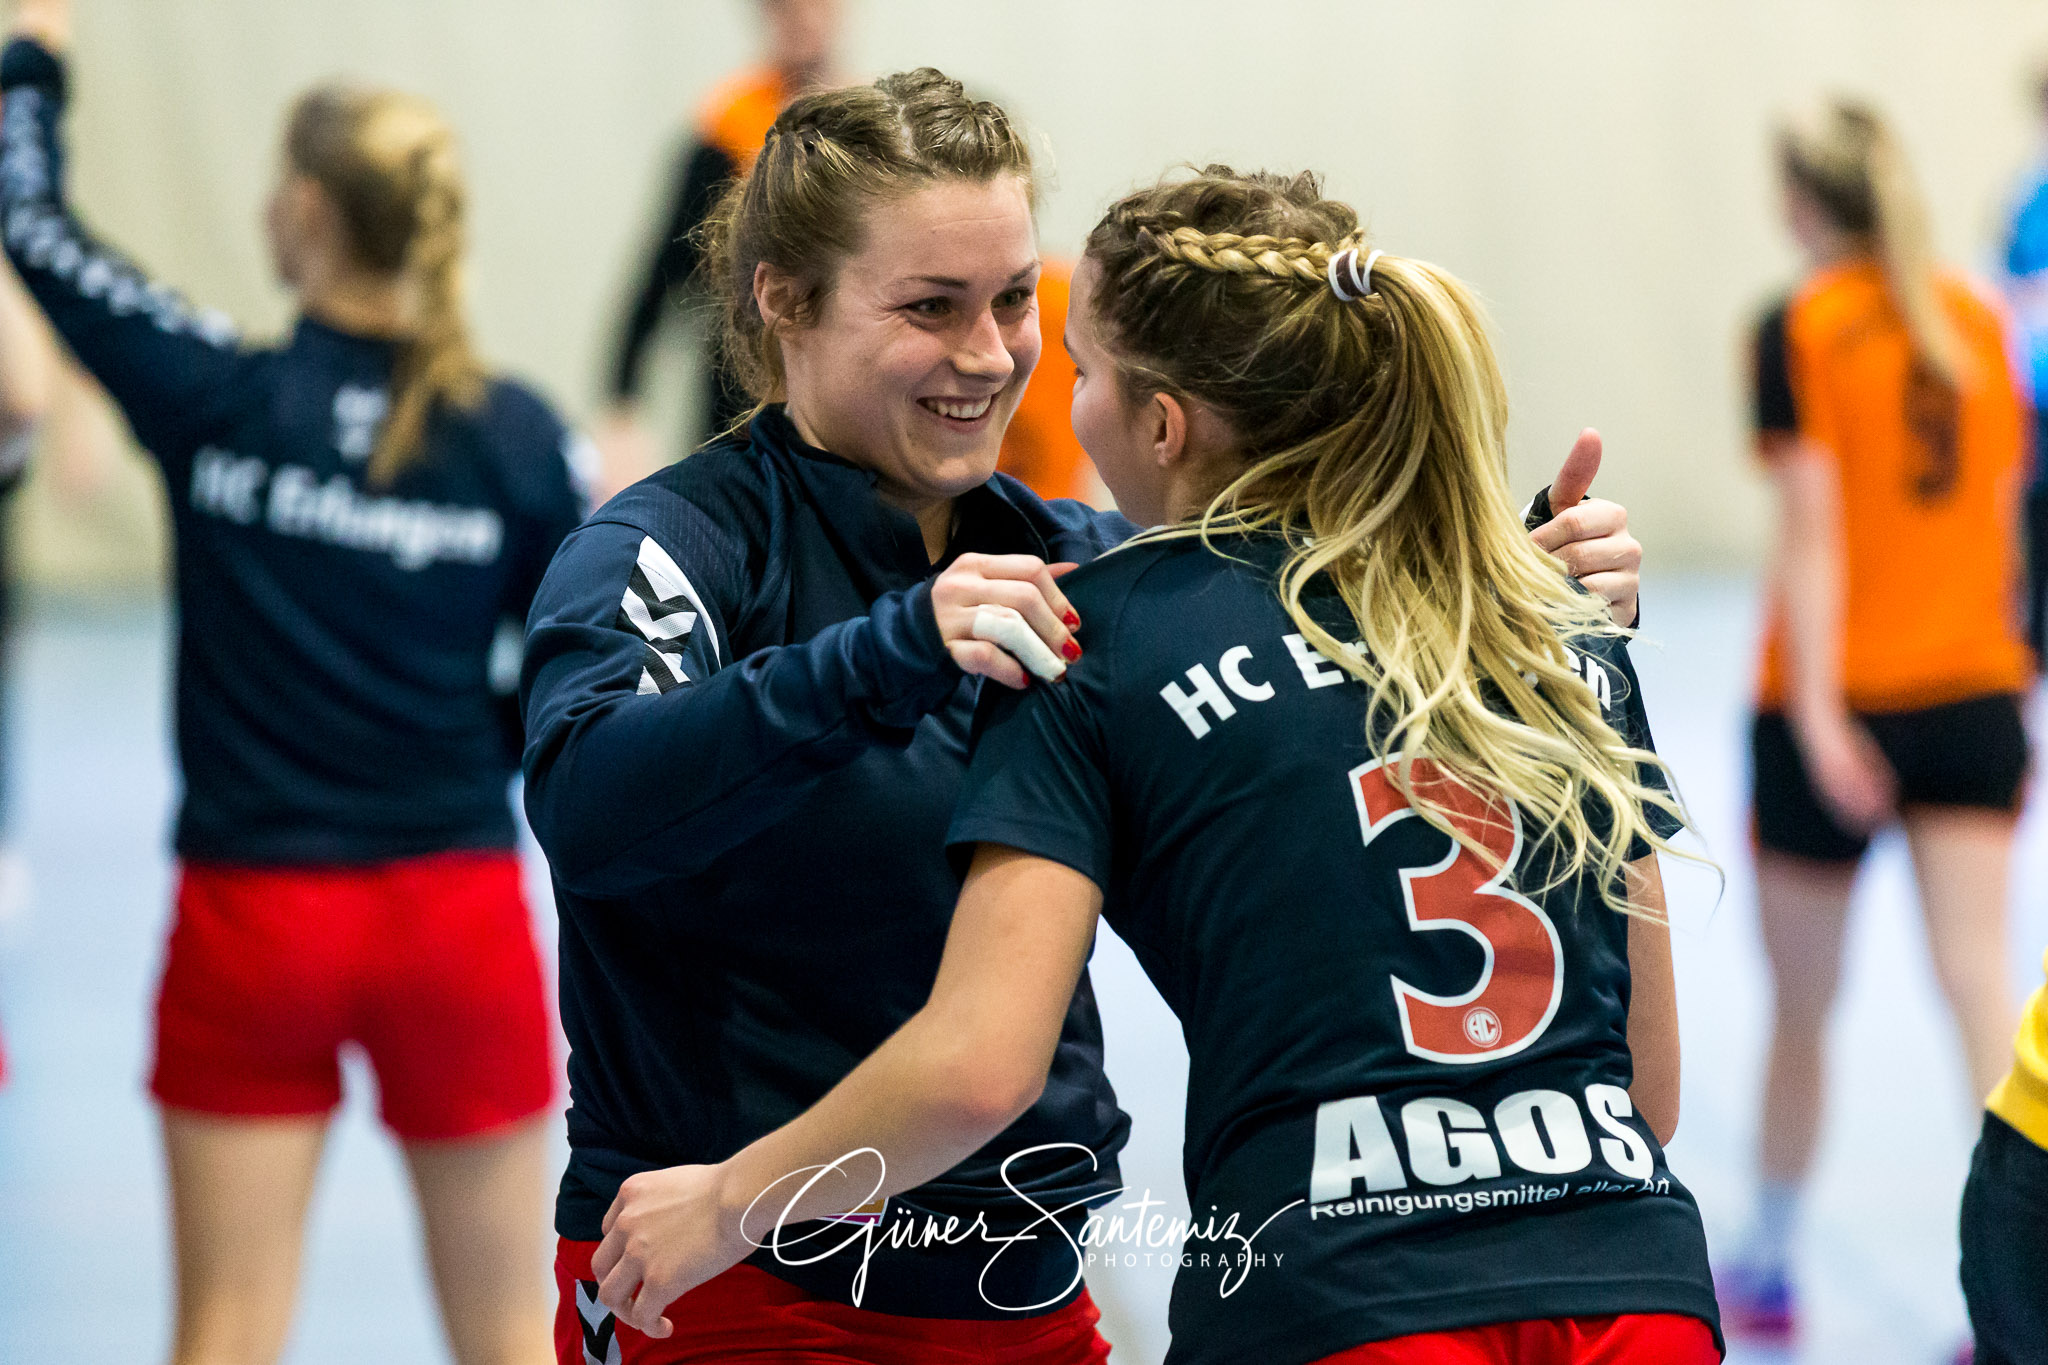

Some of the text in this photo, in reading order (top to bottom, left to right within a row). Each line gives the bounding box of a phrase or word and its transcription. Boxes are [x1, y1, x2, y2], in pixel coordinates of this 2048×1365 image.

[1159, 645, 1276, 740] HC
[1348, 742, 1565, 1065] 3
[1310, 1084, 1654, 1204] AGOS
[1310, 1183, 1568, 1220] Reinigungsmittel
